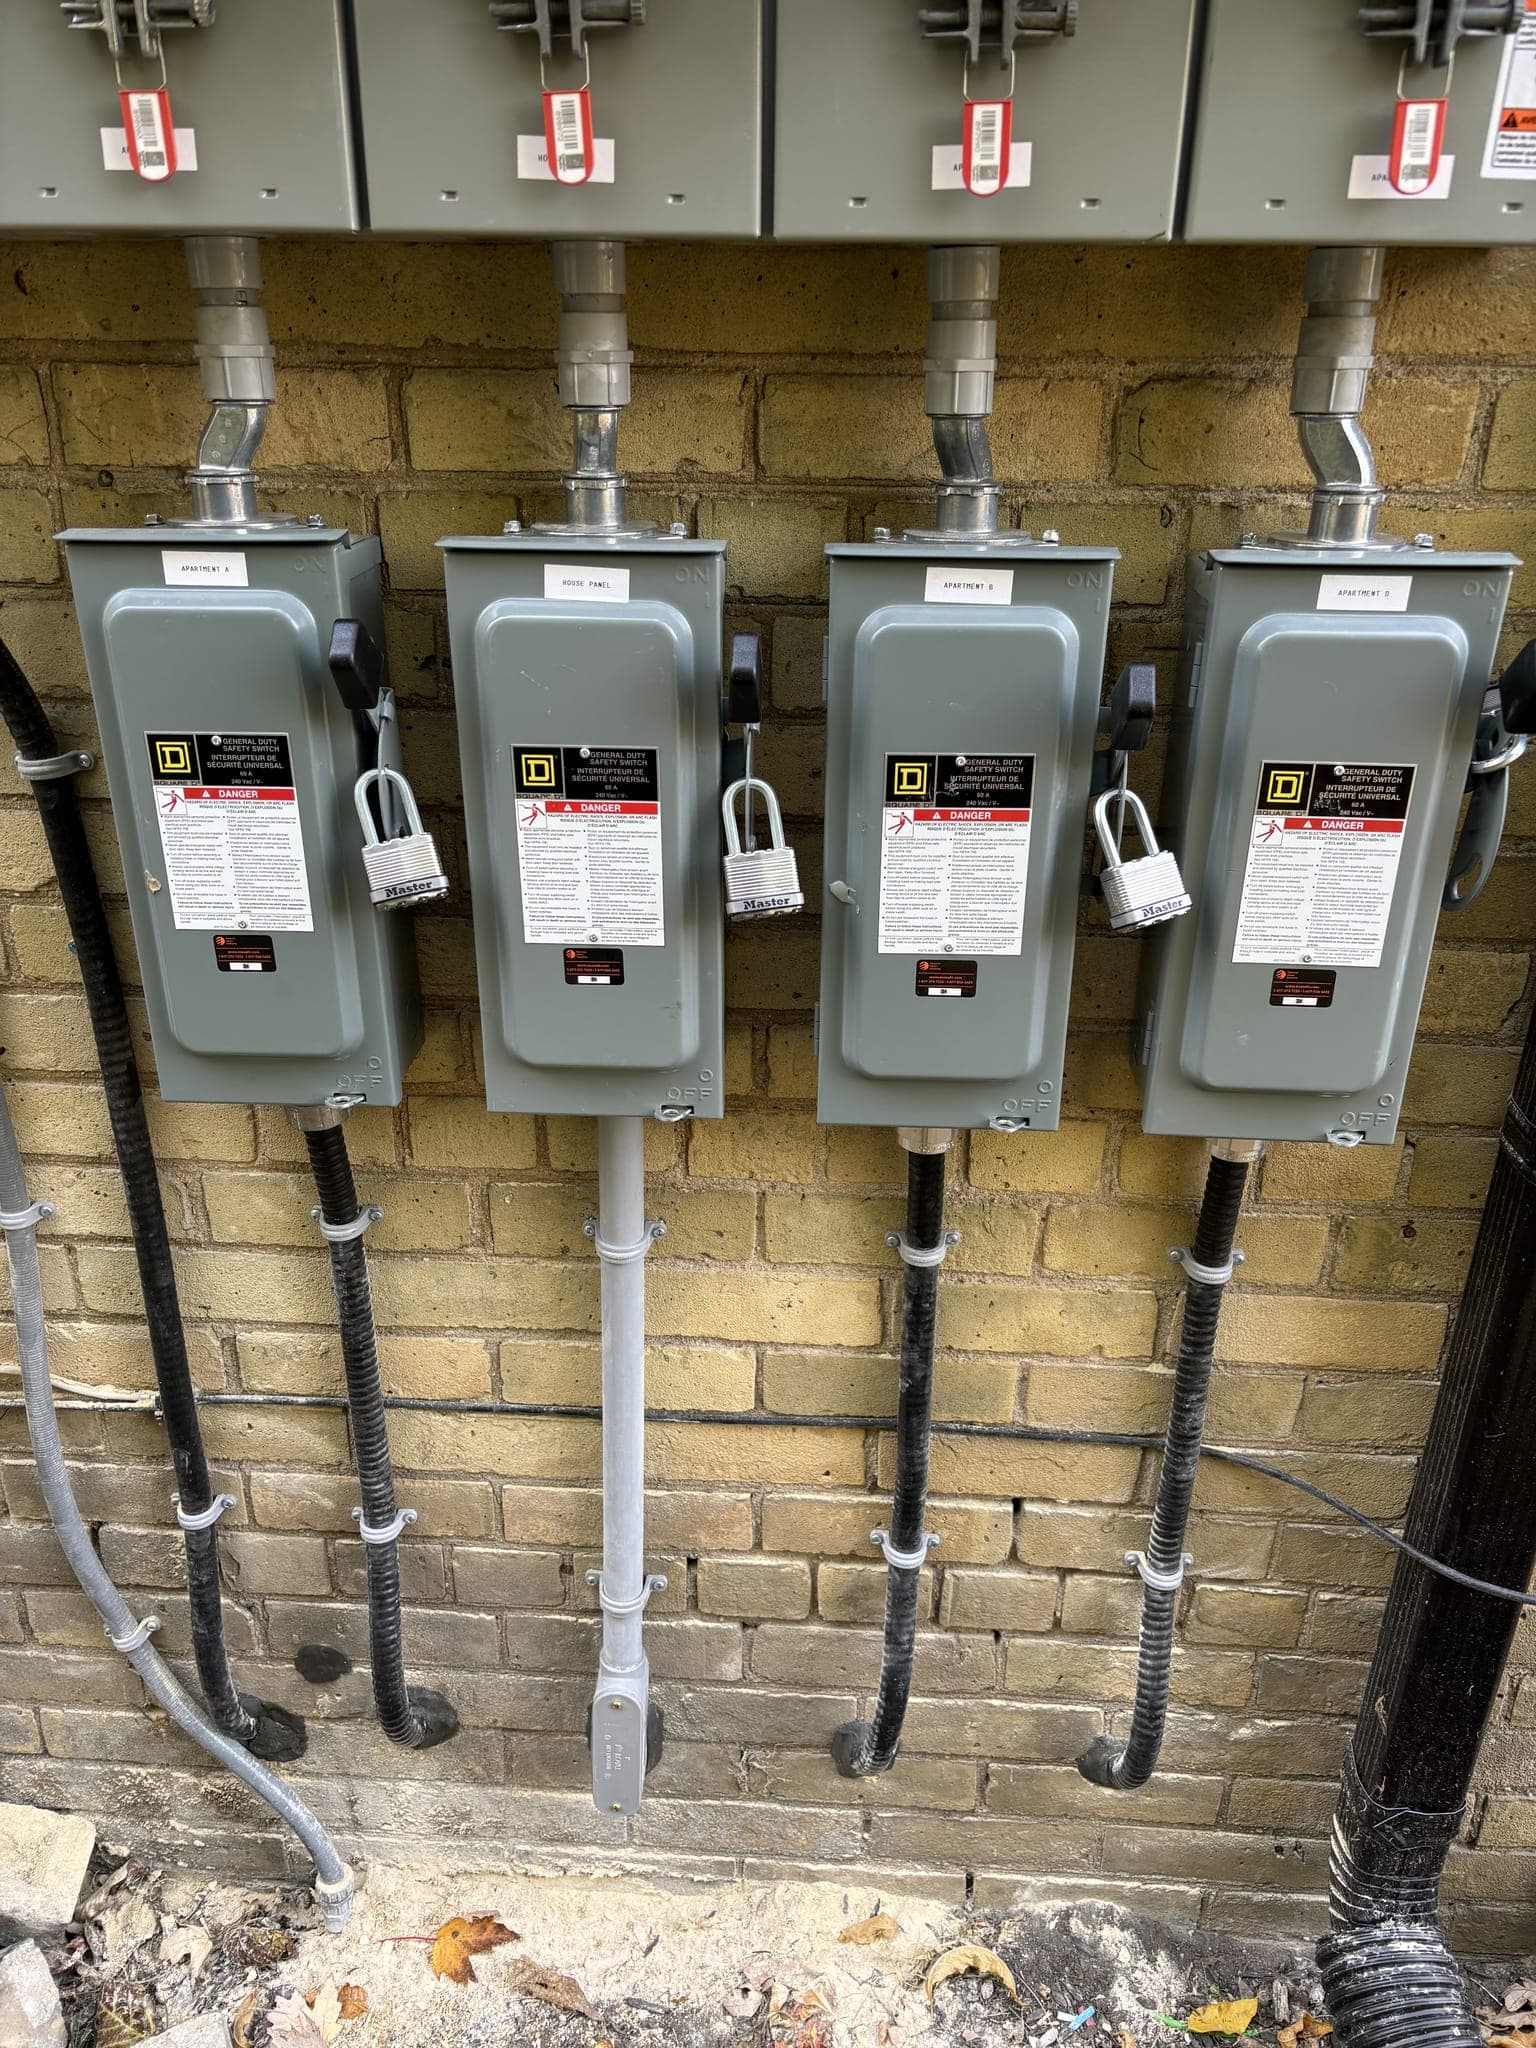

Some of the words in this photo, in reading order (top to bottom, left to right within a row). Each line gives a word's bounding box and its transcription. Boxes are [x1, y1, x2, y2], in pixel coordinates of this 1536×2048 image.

[181, 565, 221, 573] APARTMENT
[674, 566, 710, 584] ON
[1066, 570, 1102, 588] ON
[562, 579, 585, 587] HOUSE
[588, 580, 612, 589] PANEL
[943, 582, 985, 590] APARTMENT
[1463, 579, 1501, 598] ON
[1337, 589, 1380, 597] APARTMENT
[218, 790, 258, 798] DANGER
[1325, 785, 1385, 793] INTERRUPTEUR
[1358, 793, 1401, 801] UNIVERSAL
[581, 804, 621, 812] DANGER
[950, 811, 991, 820] DANGER
[1321, 821, 1364, 829] DANGER
[384, 882, 432, 898] Master
[743, 898, 790, 910] Master
[1141, 899, 1183, 917] Master
[666, 1087, 713, 1101] OFF
[1002, 1098, 1052, 1113] OFF
[1340, 1111, 1391, 1127] OFF
